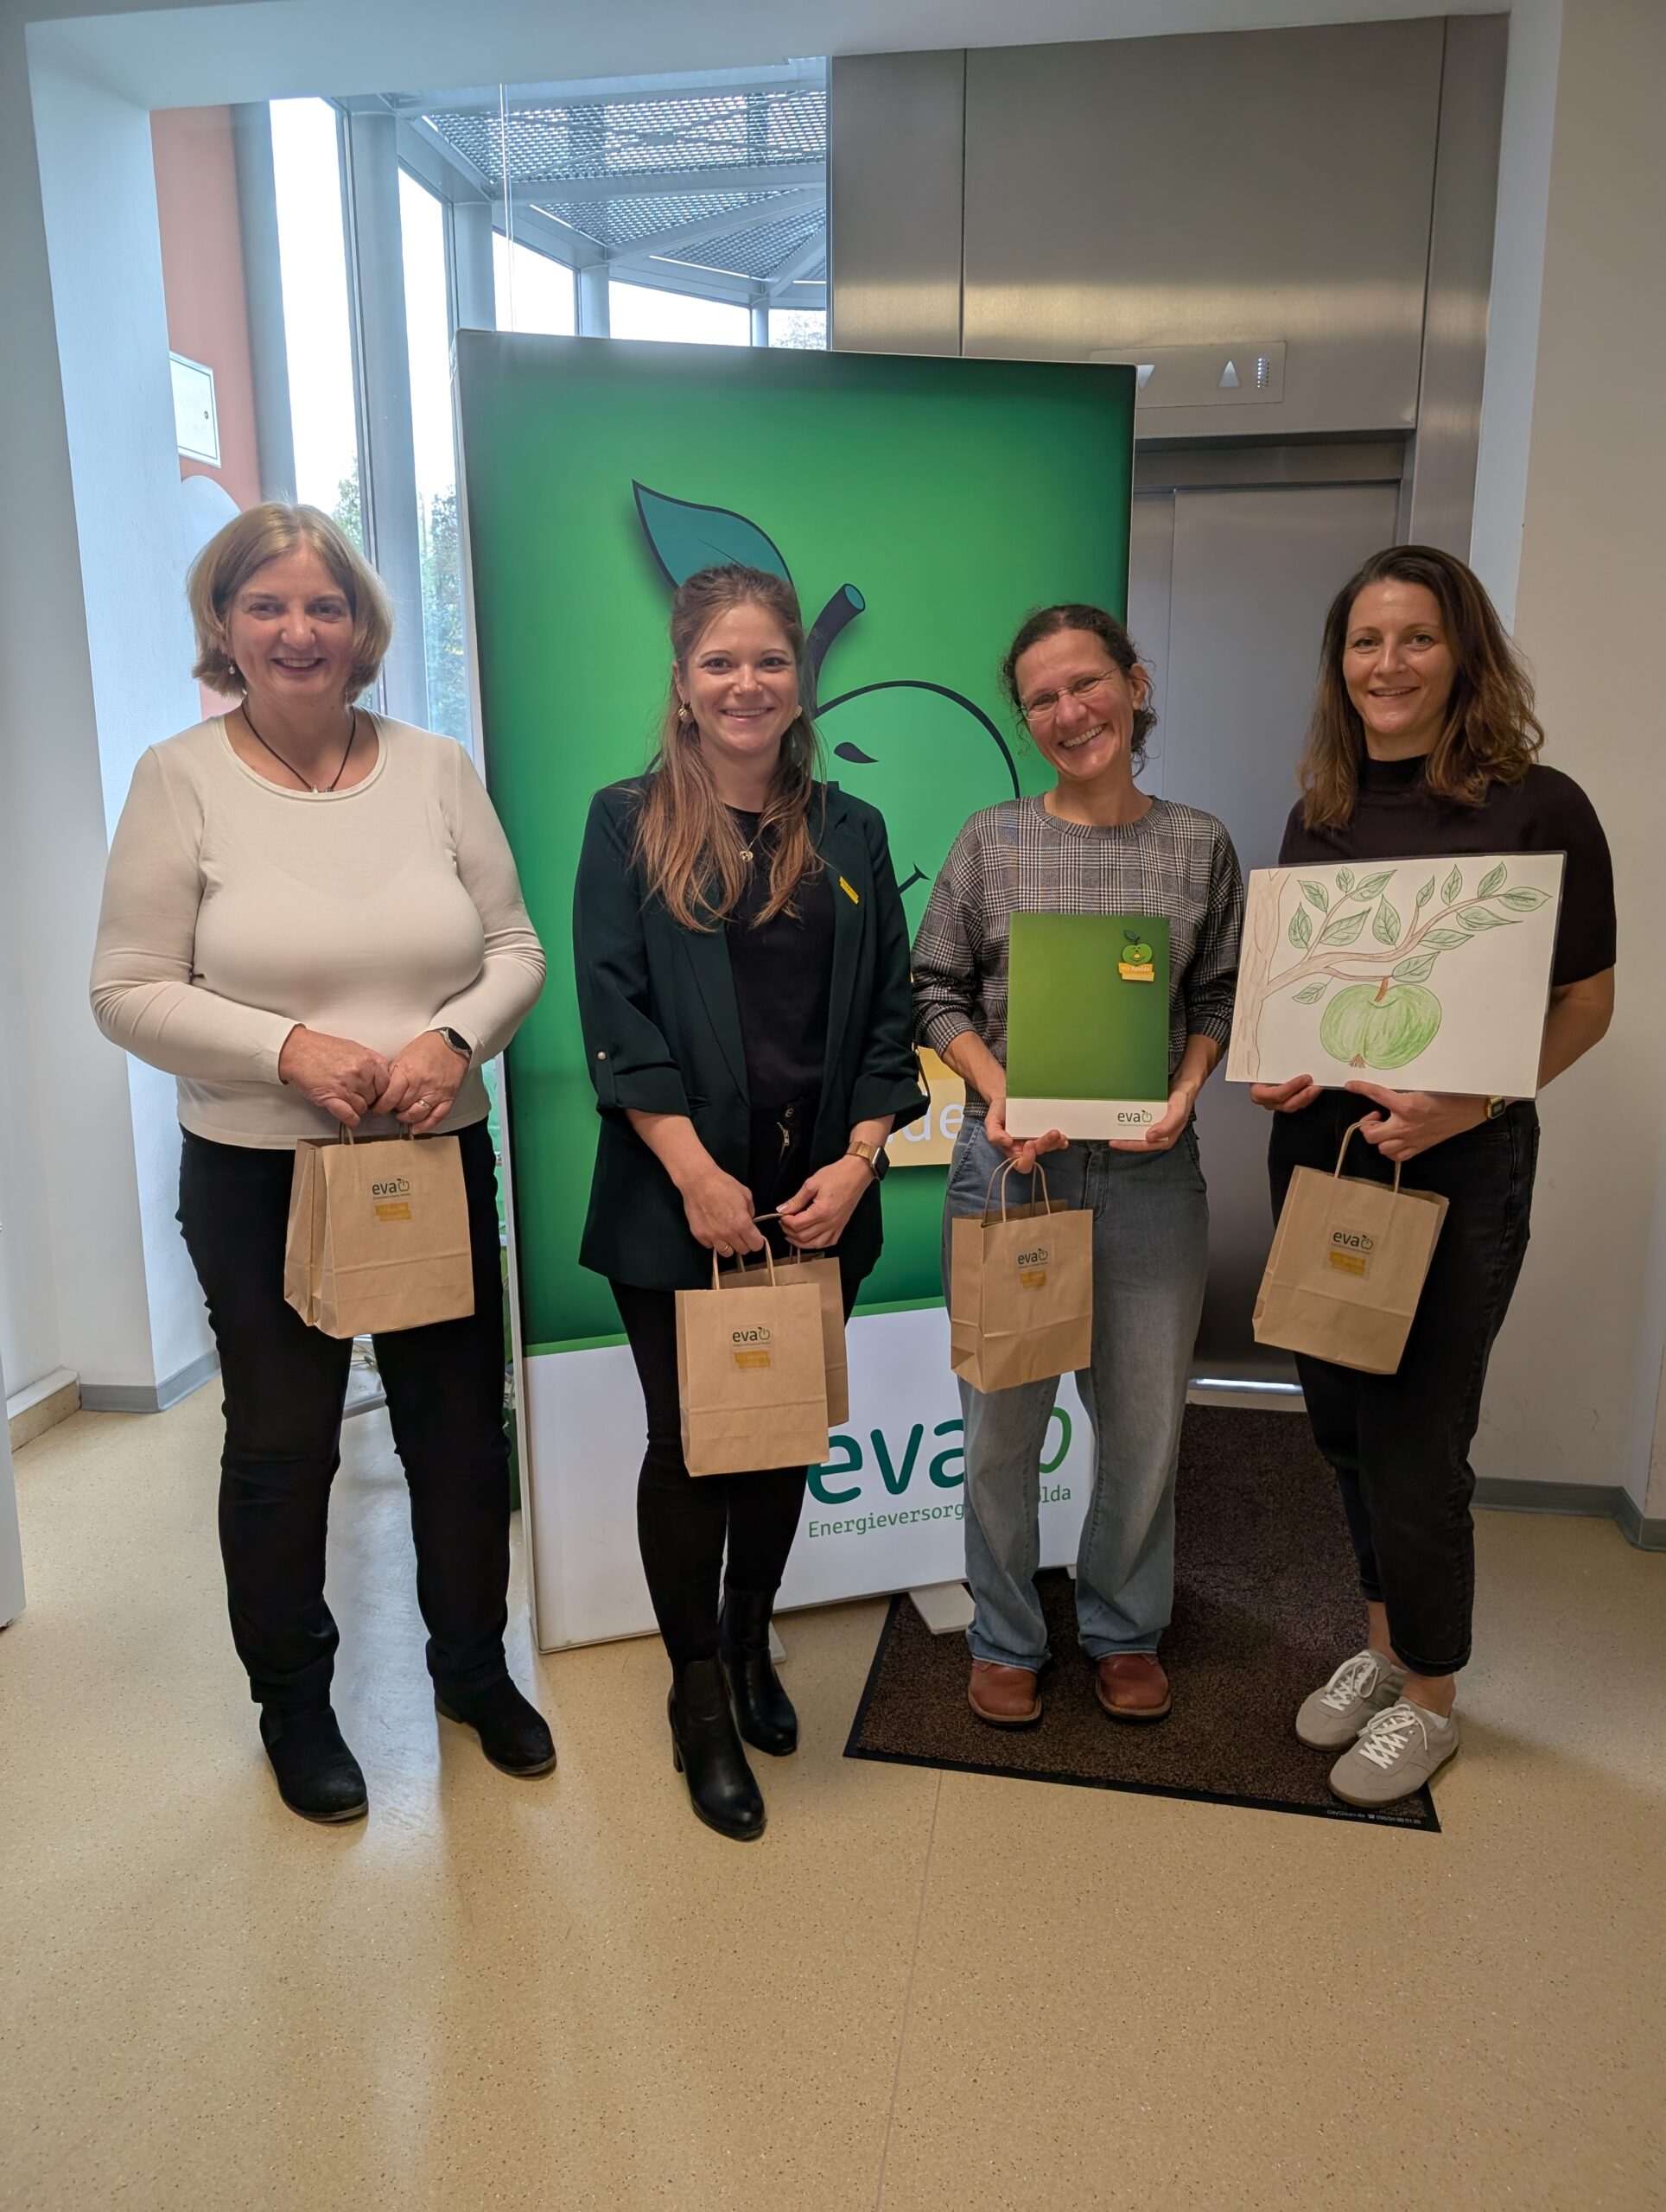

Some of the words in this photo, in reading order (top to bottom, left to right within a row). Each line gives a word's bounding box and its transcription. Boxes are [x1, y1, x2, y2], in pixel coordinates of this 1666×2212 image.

[1117, 1112, 1141, 1122] eva
[372, 1182, 397, 1195] eva
[1332, 1231, 1360, 1247] eva
[1018, 1251, 1038, 1265] eva
[732, 1330, 758, 1342] eva
[807, 1419, 964, 1504] eva
[809, 1503, 965, 1538] Energieversorg
